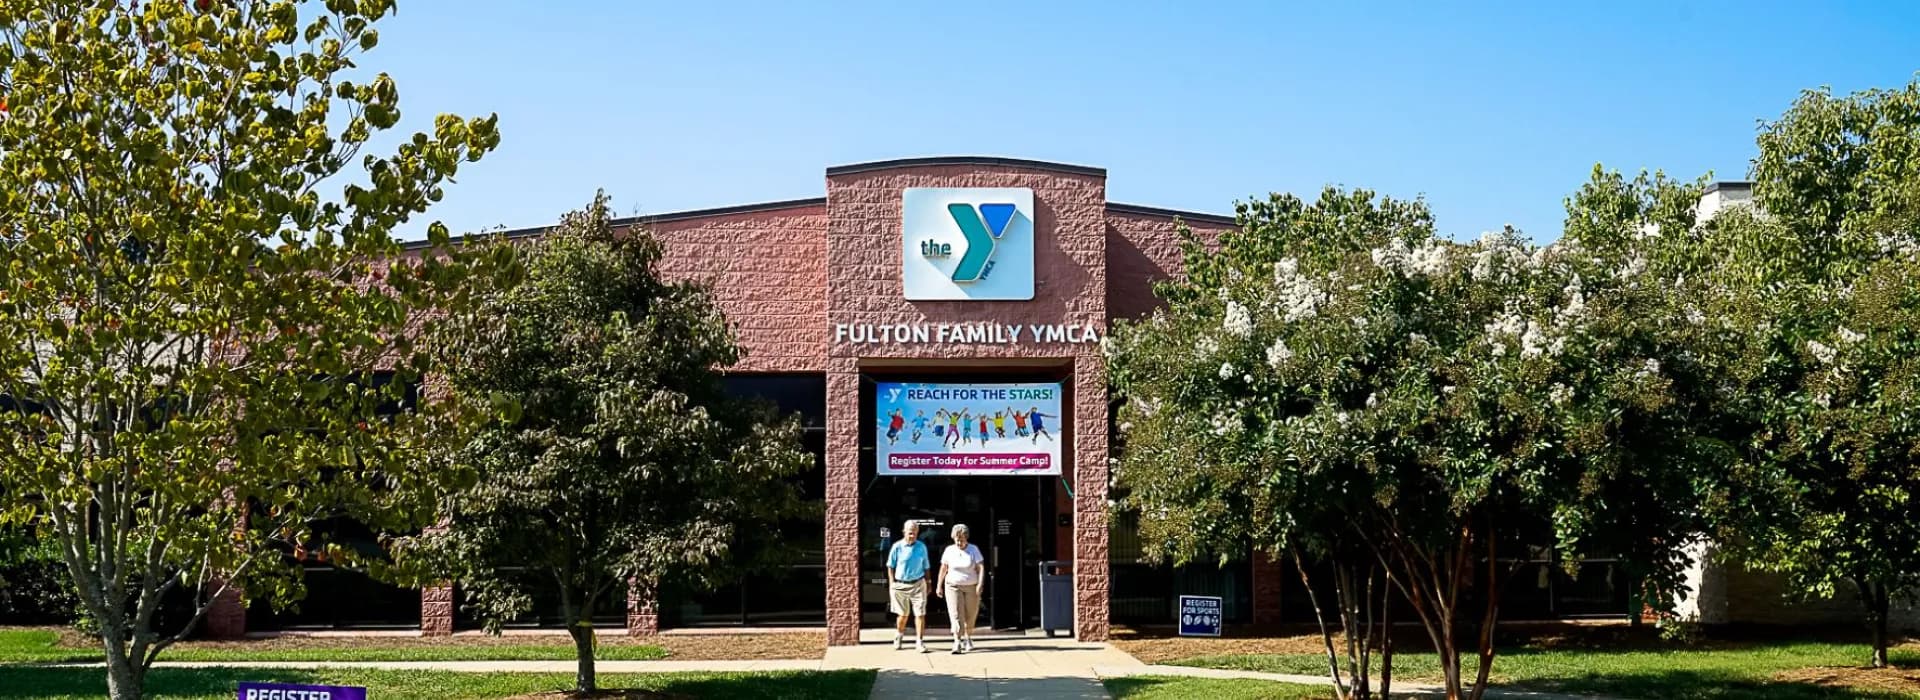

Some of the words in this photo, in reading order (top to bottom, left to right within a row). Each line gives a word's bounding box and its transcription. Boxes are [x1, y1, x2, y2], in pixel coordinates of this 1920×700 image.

[921, 238, 952, 256] the
[979, 260, 996, 281] YMCA
[835, 324, 930, 344] FULTON
[937, 324, 1023, 344] FAMILY
[1030, 324, 1099, 344] YMCA
[908, 389, 950, 400] REACH
[953, 389, 978, 400] FOR
[981, 389, 1006, 400] THE
[1009, 389, 1053, 400] STARS!
[891, 457, 930, 467] Register
[934, 457, 961, 468] Today
[963, 457, 979, 466] for
[980, 457, 1018, 466] Summer
[1020, 457, 1049, 468] Camp!
